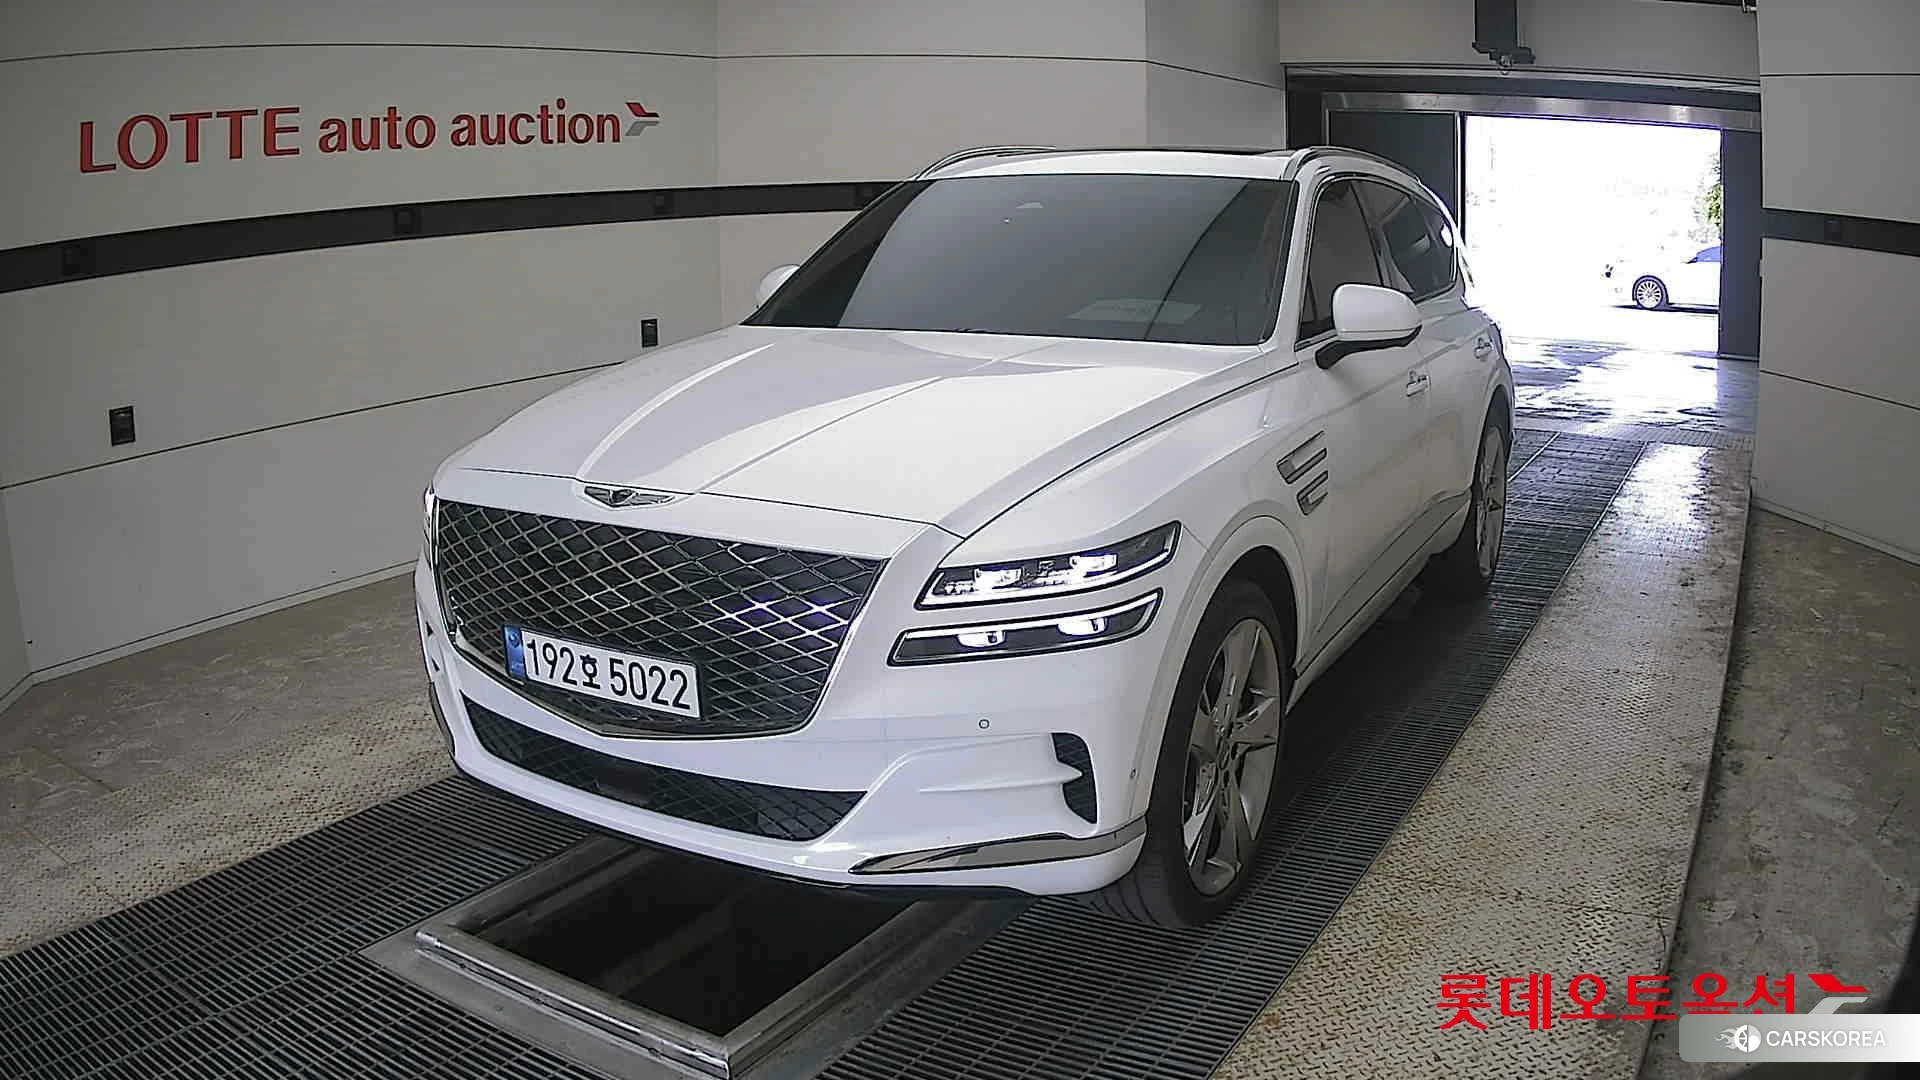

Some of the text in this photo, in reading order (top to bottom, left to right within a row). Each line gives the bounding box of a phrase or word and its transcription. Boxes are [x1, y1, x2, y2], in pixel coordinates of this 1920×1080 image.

[80, 98, 622, 173] LOTTE auto auction
[526, 639, 691, 710] 192호 5022
